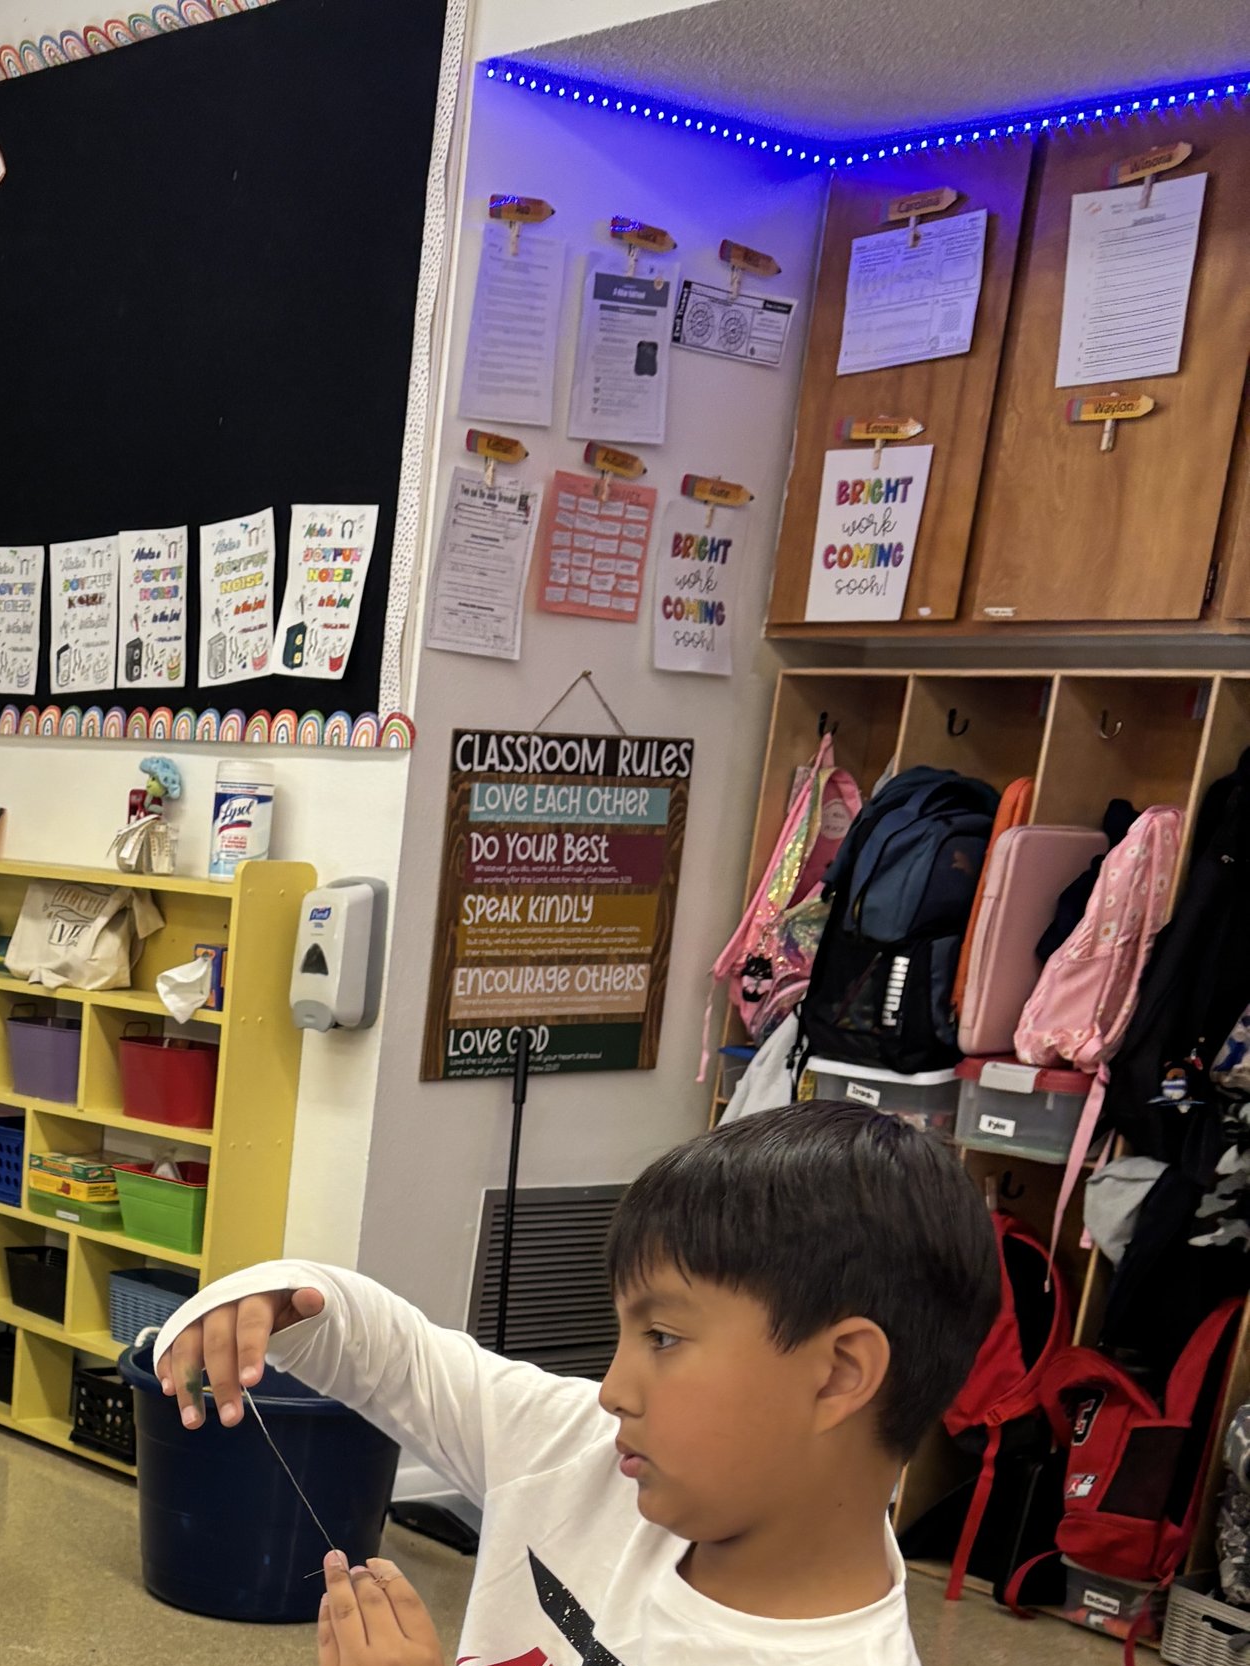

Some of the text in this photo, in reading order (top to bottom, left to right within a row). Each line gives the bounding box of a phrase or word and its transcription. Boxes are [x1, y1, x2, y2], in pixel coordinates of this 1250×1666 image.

[836, 476, 913, 506] BRIGHT
[842, 506, 896, 536] work
[672, 532, 732, 564] BRIGHT
[823, 542, 904, 570] COMING
[220, 571, 264, 594] NOISE
[835, 571, 889, 596] soon!
[662, 595, 726, 626] COMING
[455, 734, 606, 776] CLASSROOM
[221, 800, 252, 823] Lysol
[532, 784, 581, 815] EACH
[470, 832, 500, 863] DO
[505, 832, 558, 864] YOUR
